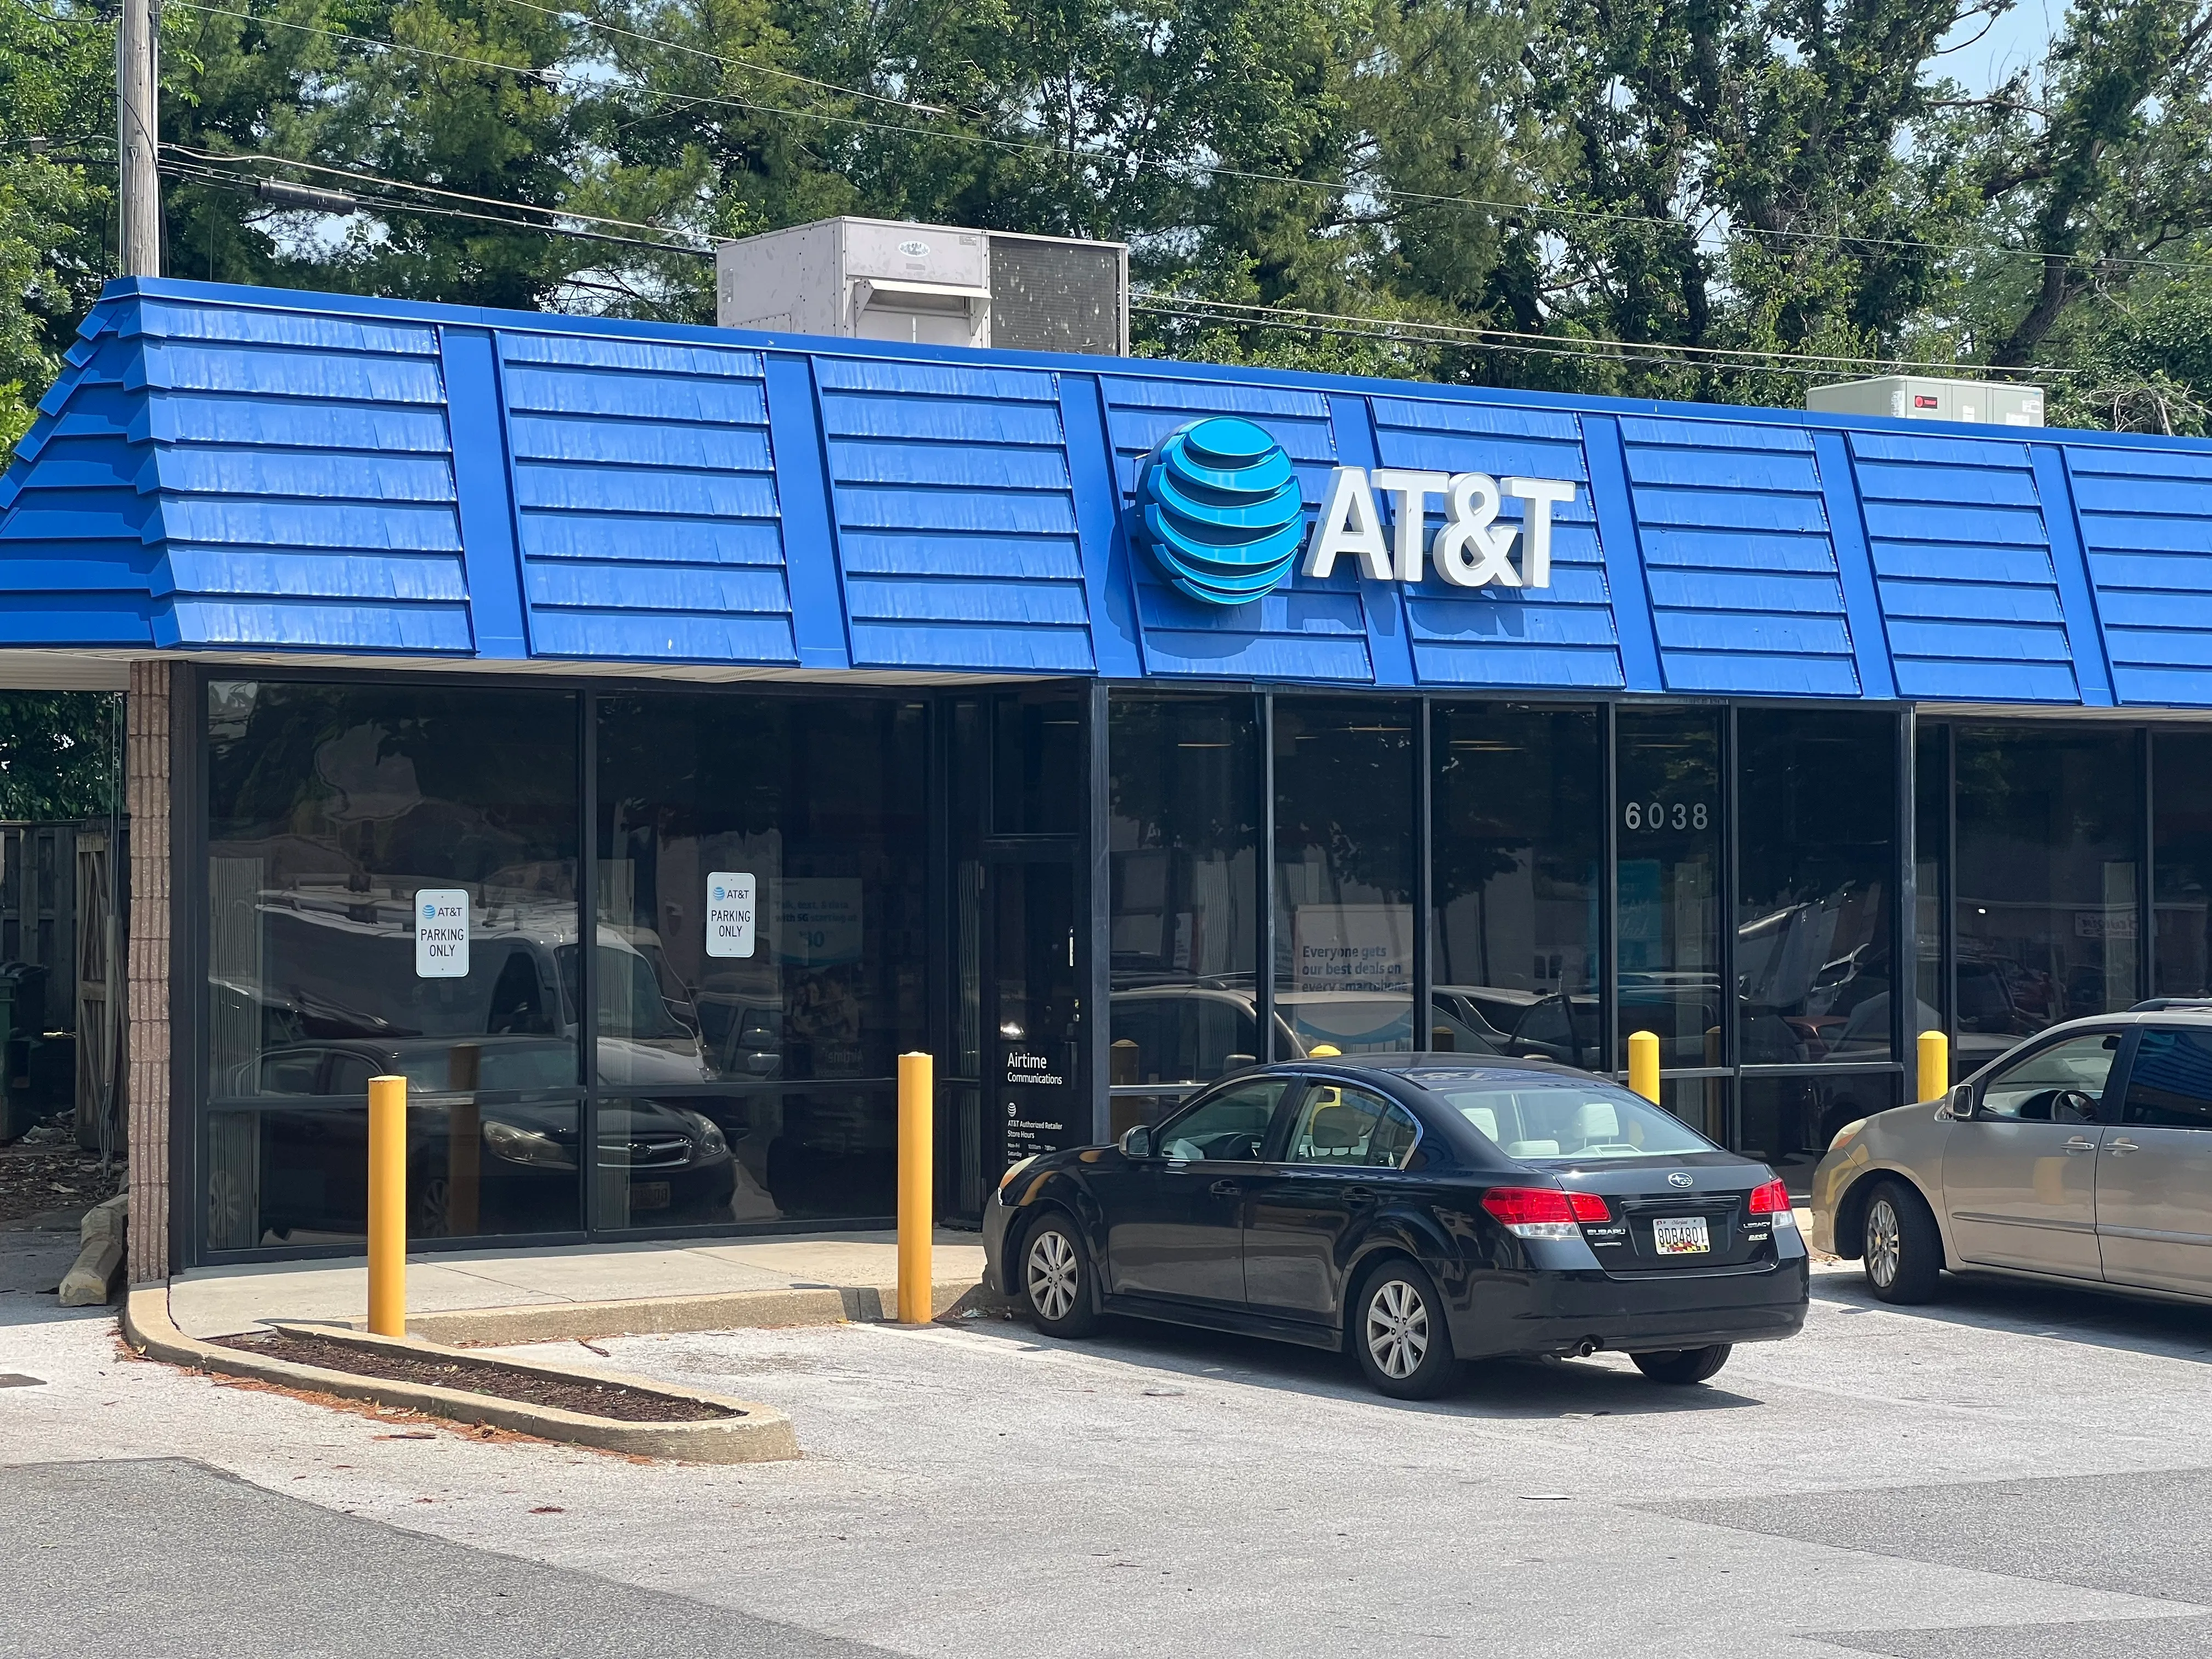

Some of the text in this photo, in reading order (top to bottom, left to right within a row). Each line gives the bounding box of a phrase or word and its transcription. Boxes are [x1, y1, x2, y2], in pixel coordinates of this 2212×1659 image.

[1301, 466, 1576, 589] AT&T
[1625, 802, 1708, 830] 6038
[726, 890, 749, 899] AT&T
[437, 907, 462, 917] AT&T
[711, 910, 751, 922] PARKING
[797, 913, 809, 922] 5G
[421, 928, 464, 941] PARKING
[719, 926, 742, 937] ONLY
[430, 944, 455, 957] ONLY
[1303, 946, 1387, 961] Everyone gets
[1302, 961, 1401, 975] our best deals on
[1302, 979, 1408, 992] every smartphone
[1007, 1052, 1047, 1069] Airtime
[1007, 1071, 1063, 1085] Communications
[1019, 1120, 1045, 1129] Authorized
[1007, 1130, 1035, 1139] Store Hours
[1658, 1227, 1705, 1245] 8DB4801
